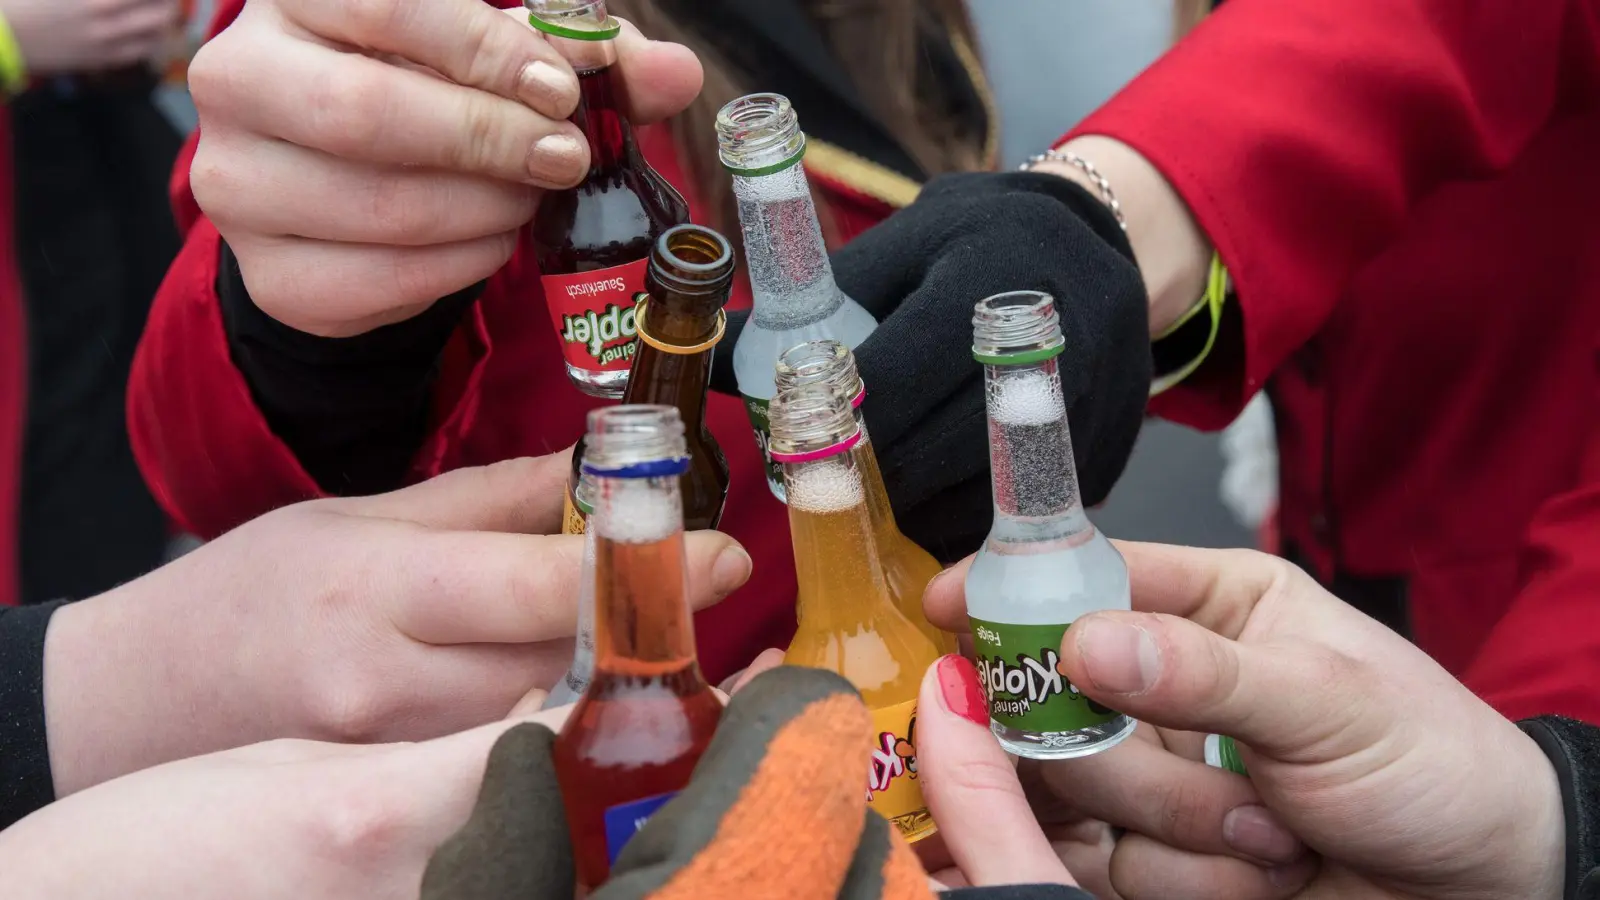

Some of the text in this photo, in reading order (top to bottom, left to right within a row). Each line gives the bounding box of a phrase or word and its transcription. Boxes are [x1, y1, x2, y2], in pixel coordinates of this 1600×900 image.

[566, 277, 625, 299] Sauerkirsch
[562, 305, 637, 356] opfer
[600, 341, 636, 366] einer
[977, 625, 1002, 647] Feige
[976, 650, 1063, 703] Klopfe
[994, 698, 1031, 717] kleiner
